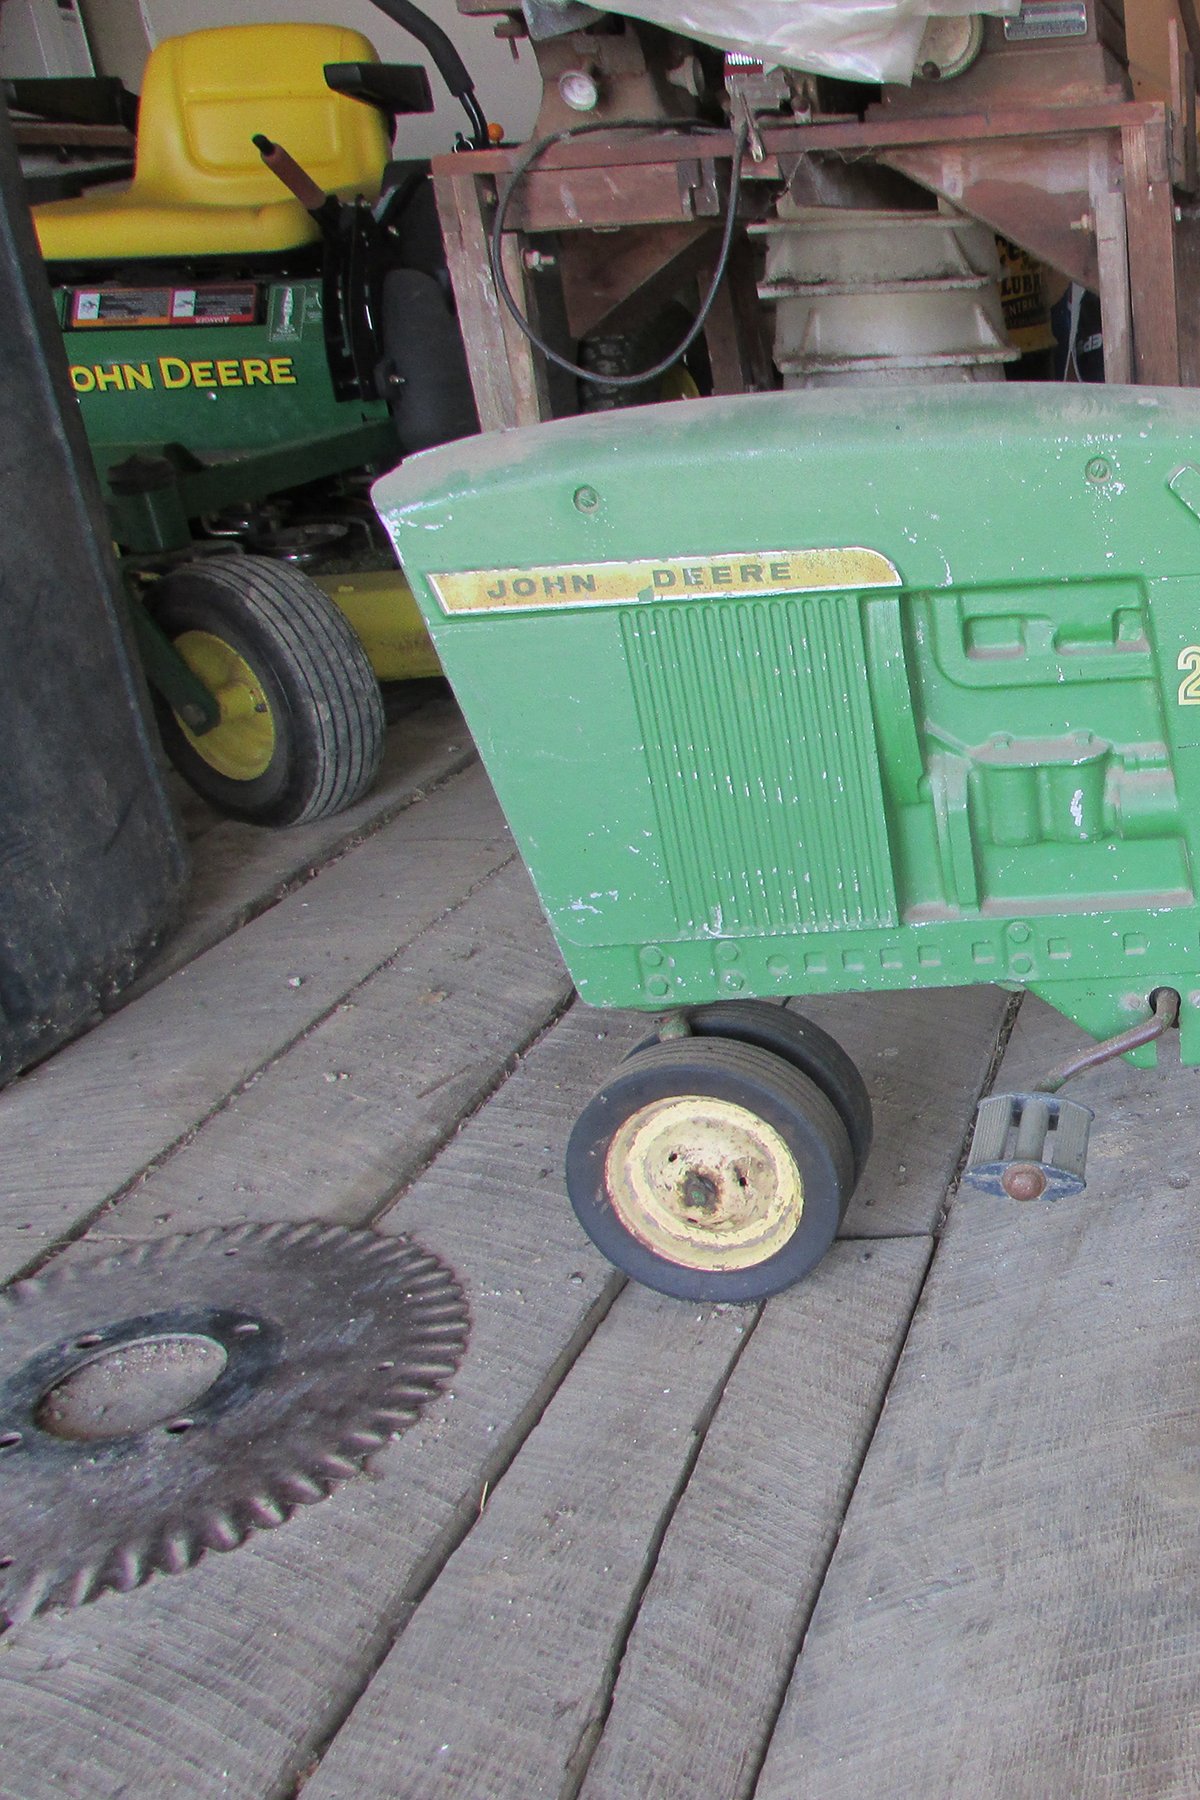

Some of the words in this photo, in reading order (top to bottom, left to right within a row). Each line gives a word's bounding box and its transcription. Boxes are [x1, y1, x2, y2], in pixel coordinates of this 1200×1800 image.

[68, 362, 154, 393] OHN
[157, 356, 298, 390] DEERE
[487, 573, 597, 600] JOHN
[652, 561, 792, 589] DEERE
